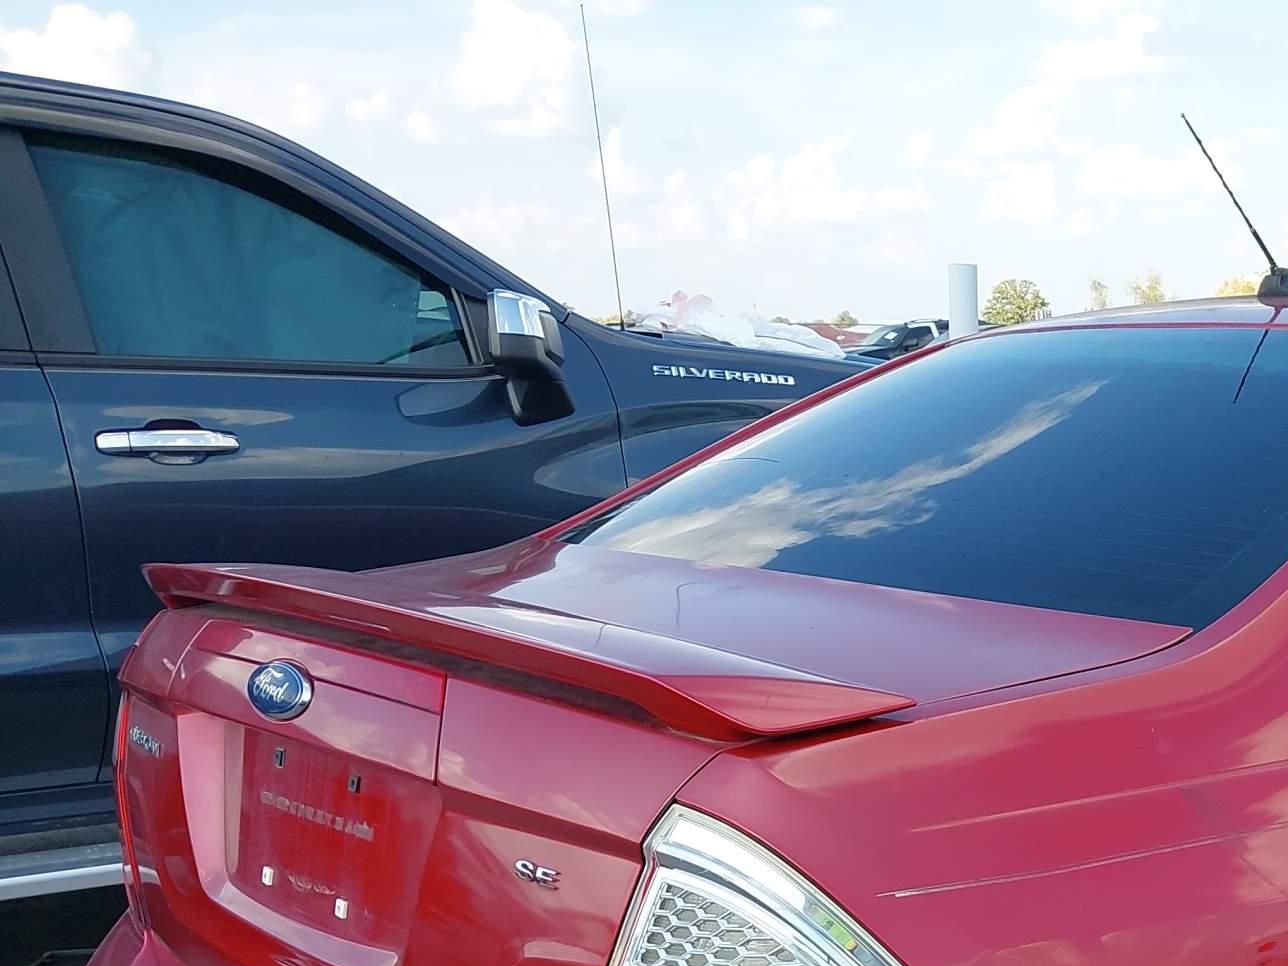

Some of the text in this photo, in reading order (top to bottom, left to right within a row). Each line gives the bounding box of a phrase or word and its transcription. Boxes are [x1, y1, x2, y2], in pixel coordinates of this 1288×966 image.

[652, 365, 795, 385] SILVERADO
[253, 667, 289, 703] Ford
[515, 860, 561, 890] SE
